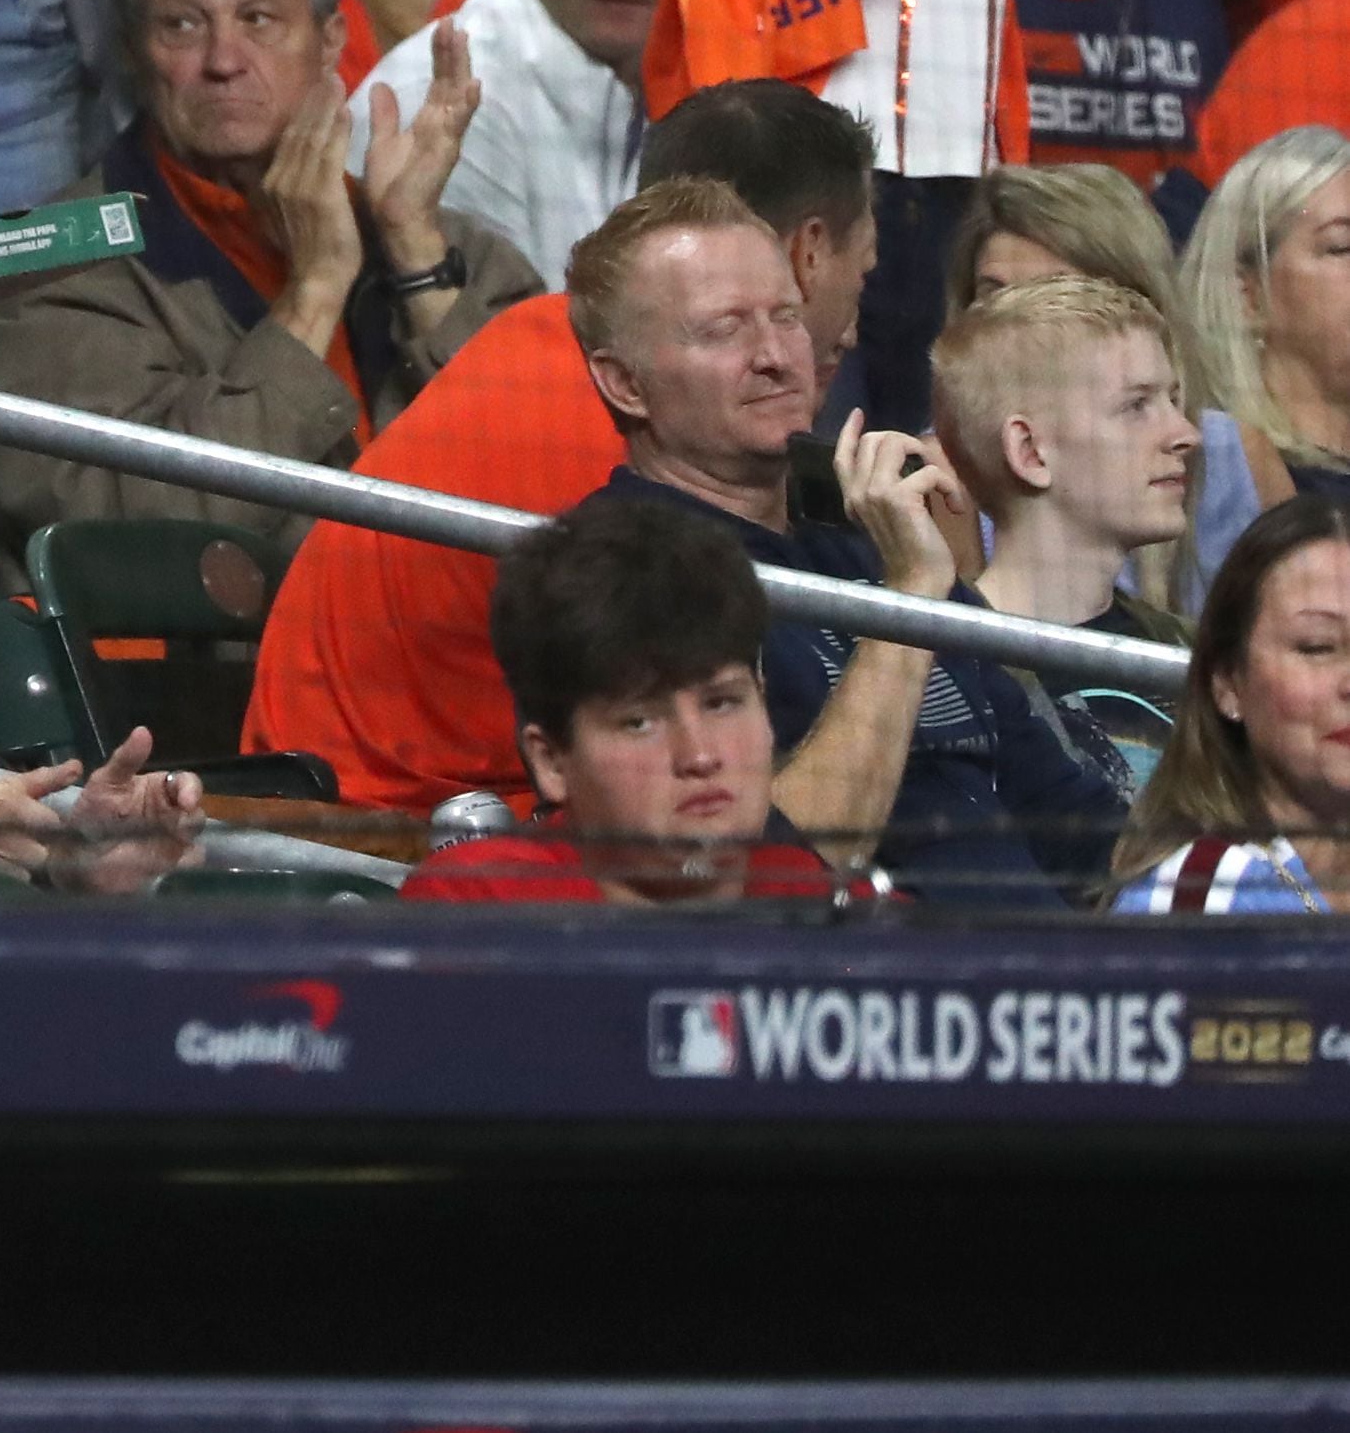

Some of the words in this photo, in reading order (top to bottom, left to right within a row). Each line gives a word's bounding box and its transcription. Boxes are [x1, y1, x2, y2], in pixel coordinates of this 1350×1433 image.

[1077, 31, 1200, 87] WORLD
[1028, 83, 1185, 140] SERIES
[22, 227, 38, 240] THE
[741, 986, 980, 1083] WORLD
[988, 991, 1187, 1088] SERIES
[1191, 1019, 1313, 1065] 2022
